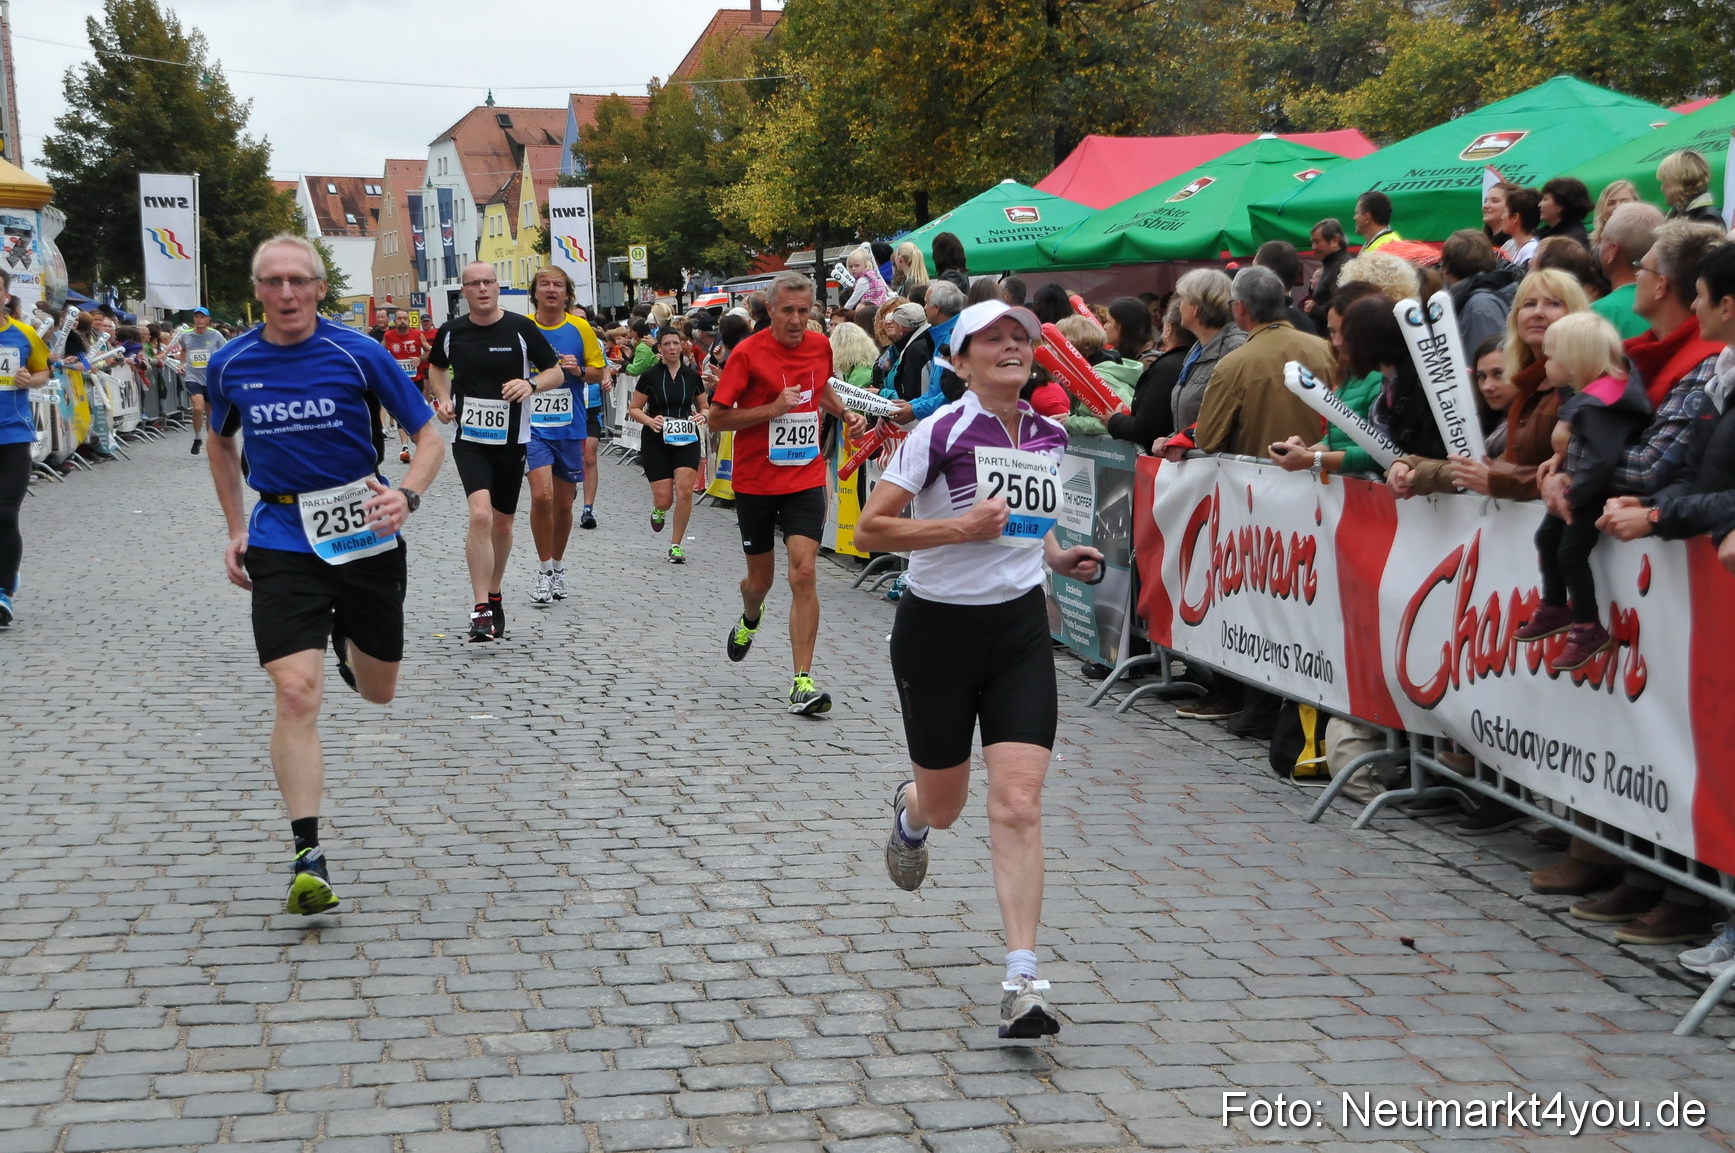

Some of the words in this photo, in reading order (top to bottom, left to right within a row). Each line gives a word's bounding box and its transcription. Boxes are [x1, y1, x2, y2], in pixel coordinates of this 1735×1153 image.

[1367, 172, 1538, 192] Lammsbäu
[1416, 338, 1446, 384] BMW
[250, 398, 336, 424] SYSCAD
[534, 397, 569, 412] 2743
[846, 398, 868, 410] BMW
[254, 419, 343, 435] www.metallbau-cad.de
[466, 409, 505, 428] 2186
[667, 422, 693, 433] 2380
[470, 430, 498, 438] Christian
[775, 425, 816, 446] 2492
[978, 456, 1010, 467] PARTL
[1012, 459, 1048, 474] Neumarkt
[987, 471, 1057, 513] 2560
[302, 498, 332, 509] PARTL
[1003, 520, 1038, 536] ngelika
[332, 531, 377, 554] Michael
[1178, 482, 1318, 626] Charivari
[1220, 619, 1290, 670] Ostbayerns
[1294, 643, 1334, 685] Radio
[1471, 709, 1596, 786] Ostbayerns
[1604, 750, 1669, 812] Radio
